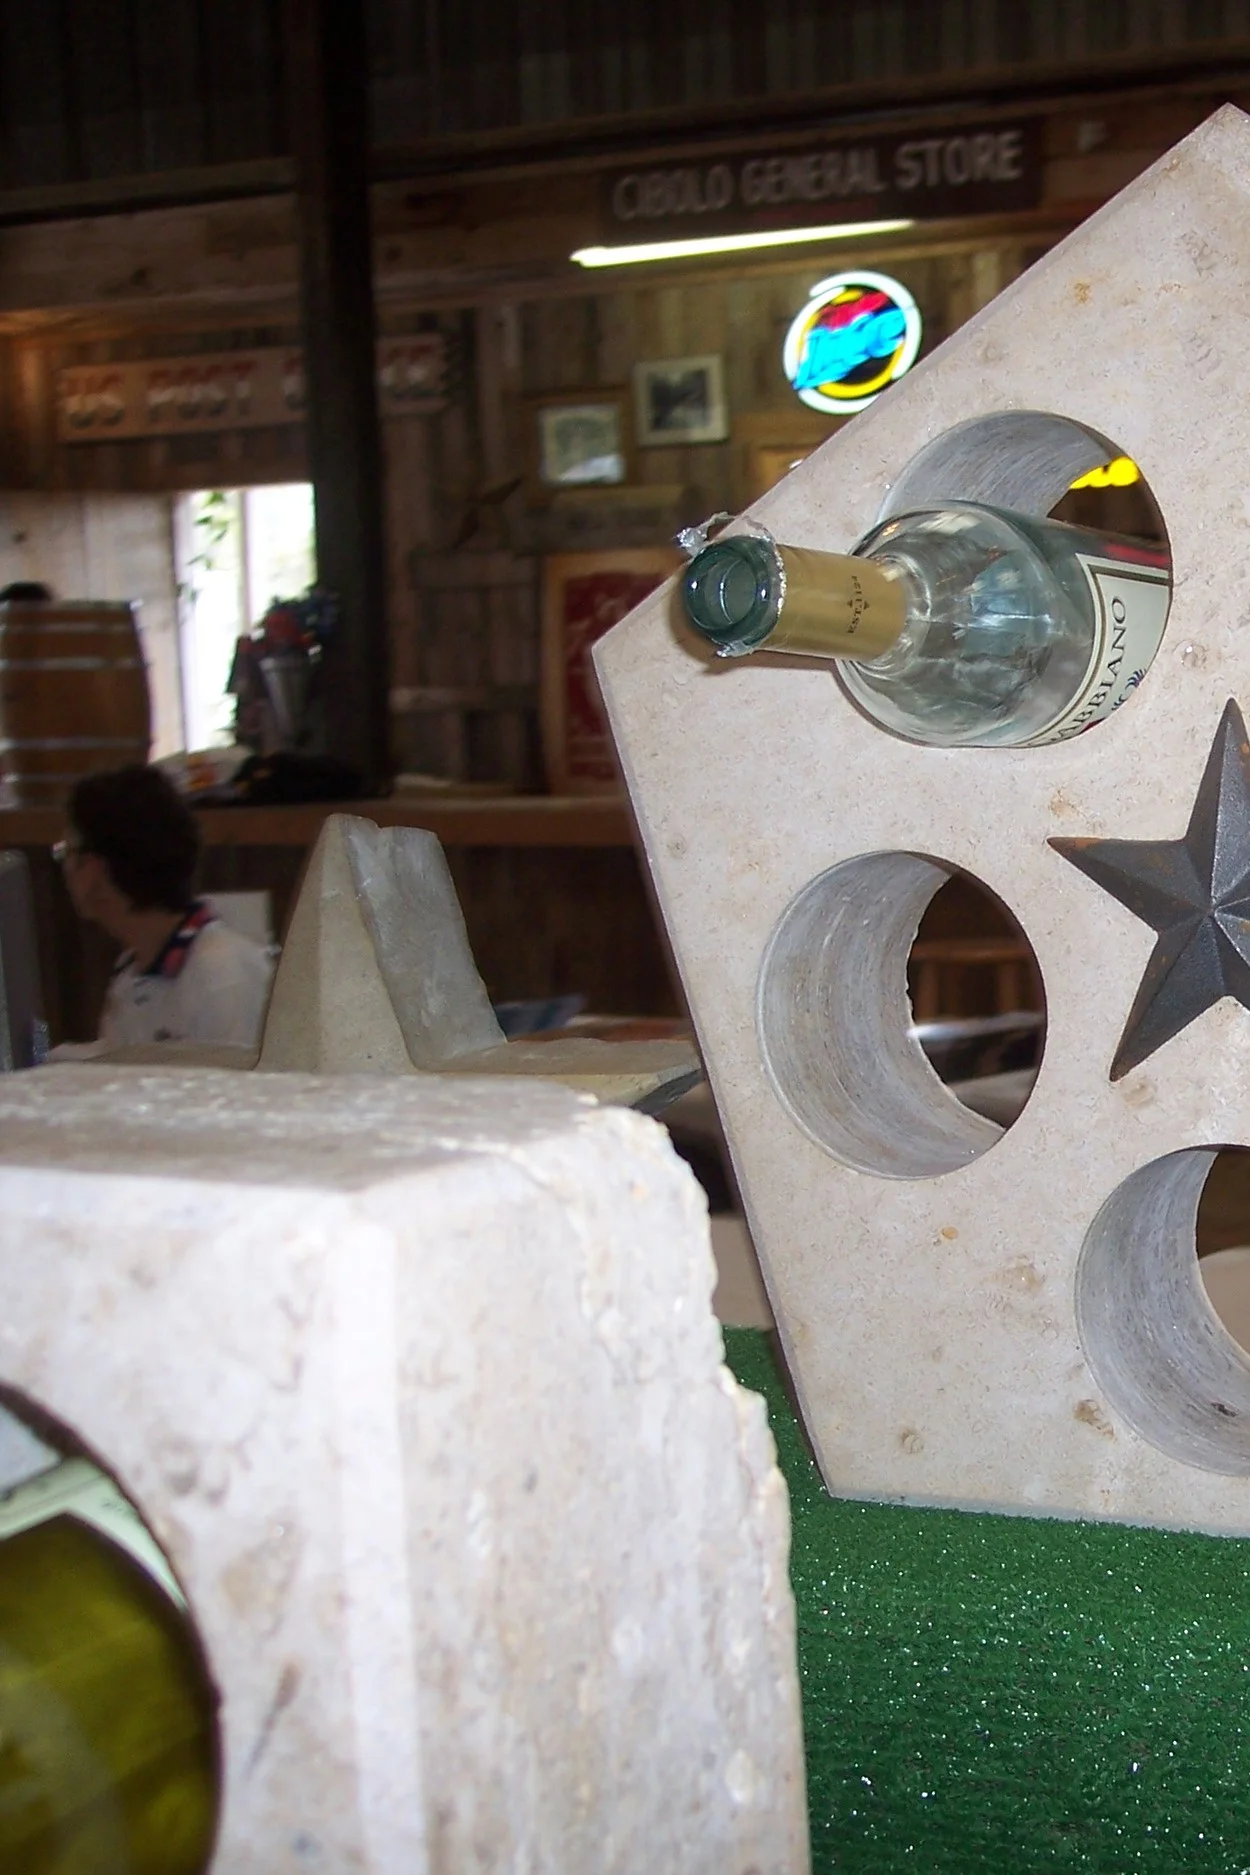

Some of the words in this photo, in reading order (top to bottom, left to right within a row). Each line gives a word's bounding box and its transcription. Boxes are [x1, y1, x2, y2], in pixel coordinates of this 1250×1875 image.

[612, 164, 735, 220] CIBOLO
[741, 149, 887, 205] GENERAL
[894, 131, 1023, 190] STORE
[148, 360, 257, 422] POST
[1047, 595, 1127, 743] ABBIANO
